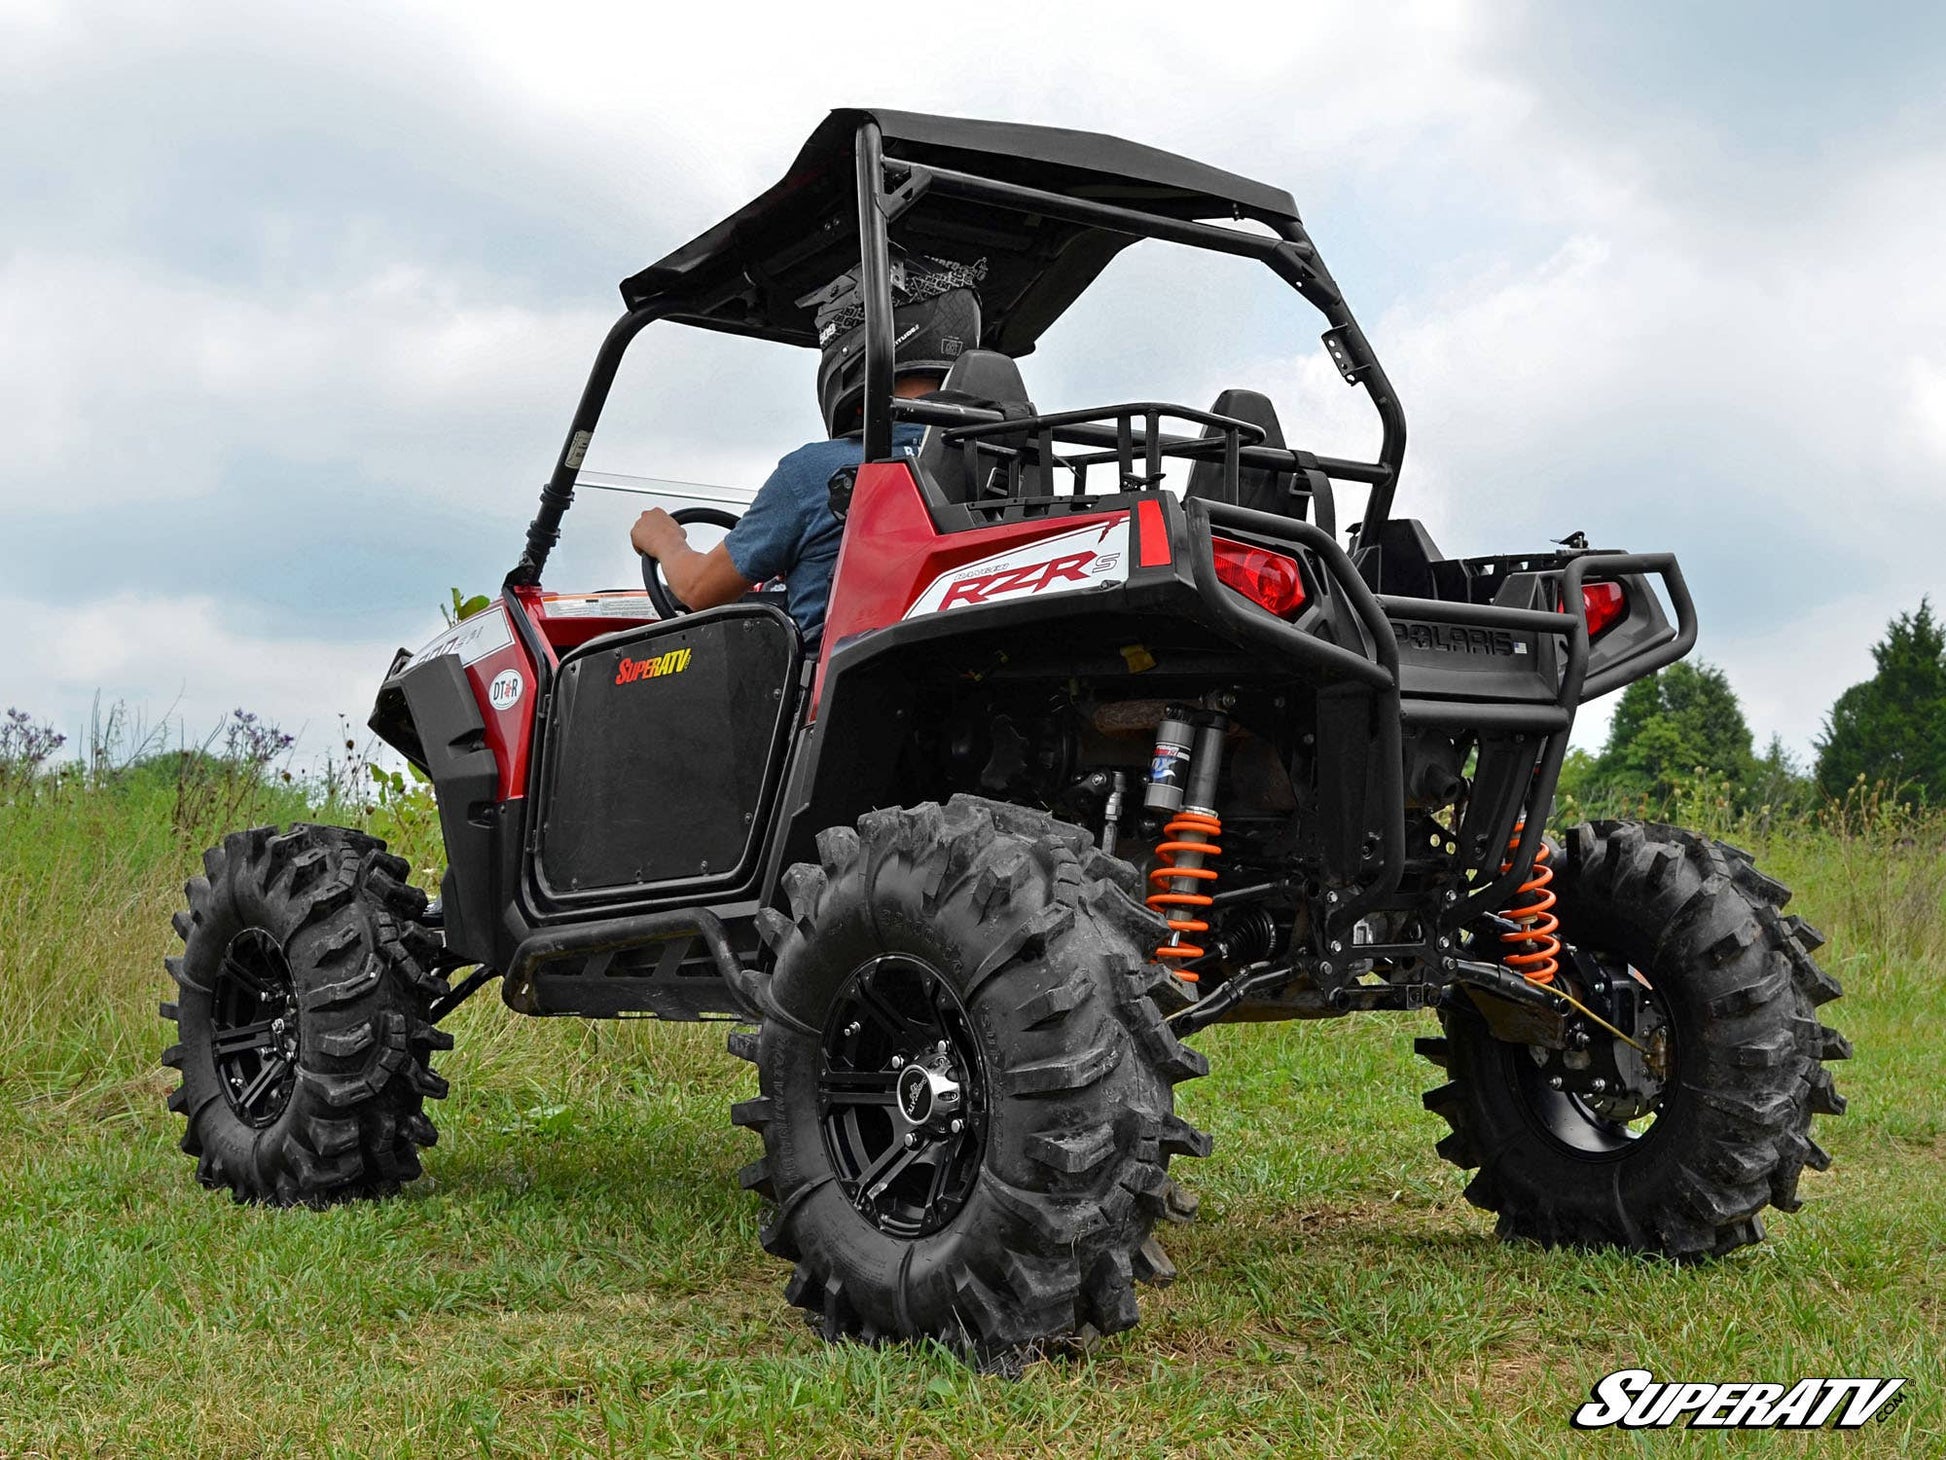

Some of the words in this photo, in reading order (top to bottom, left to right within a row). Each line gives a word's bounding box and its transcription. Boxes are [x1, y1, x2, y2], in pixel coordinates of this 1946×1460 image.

[937, 551, 1098, 612] RZR
[1391, 622, 1513, 656] POLARIS
[616, 648, 691, 685] SUPERATV
